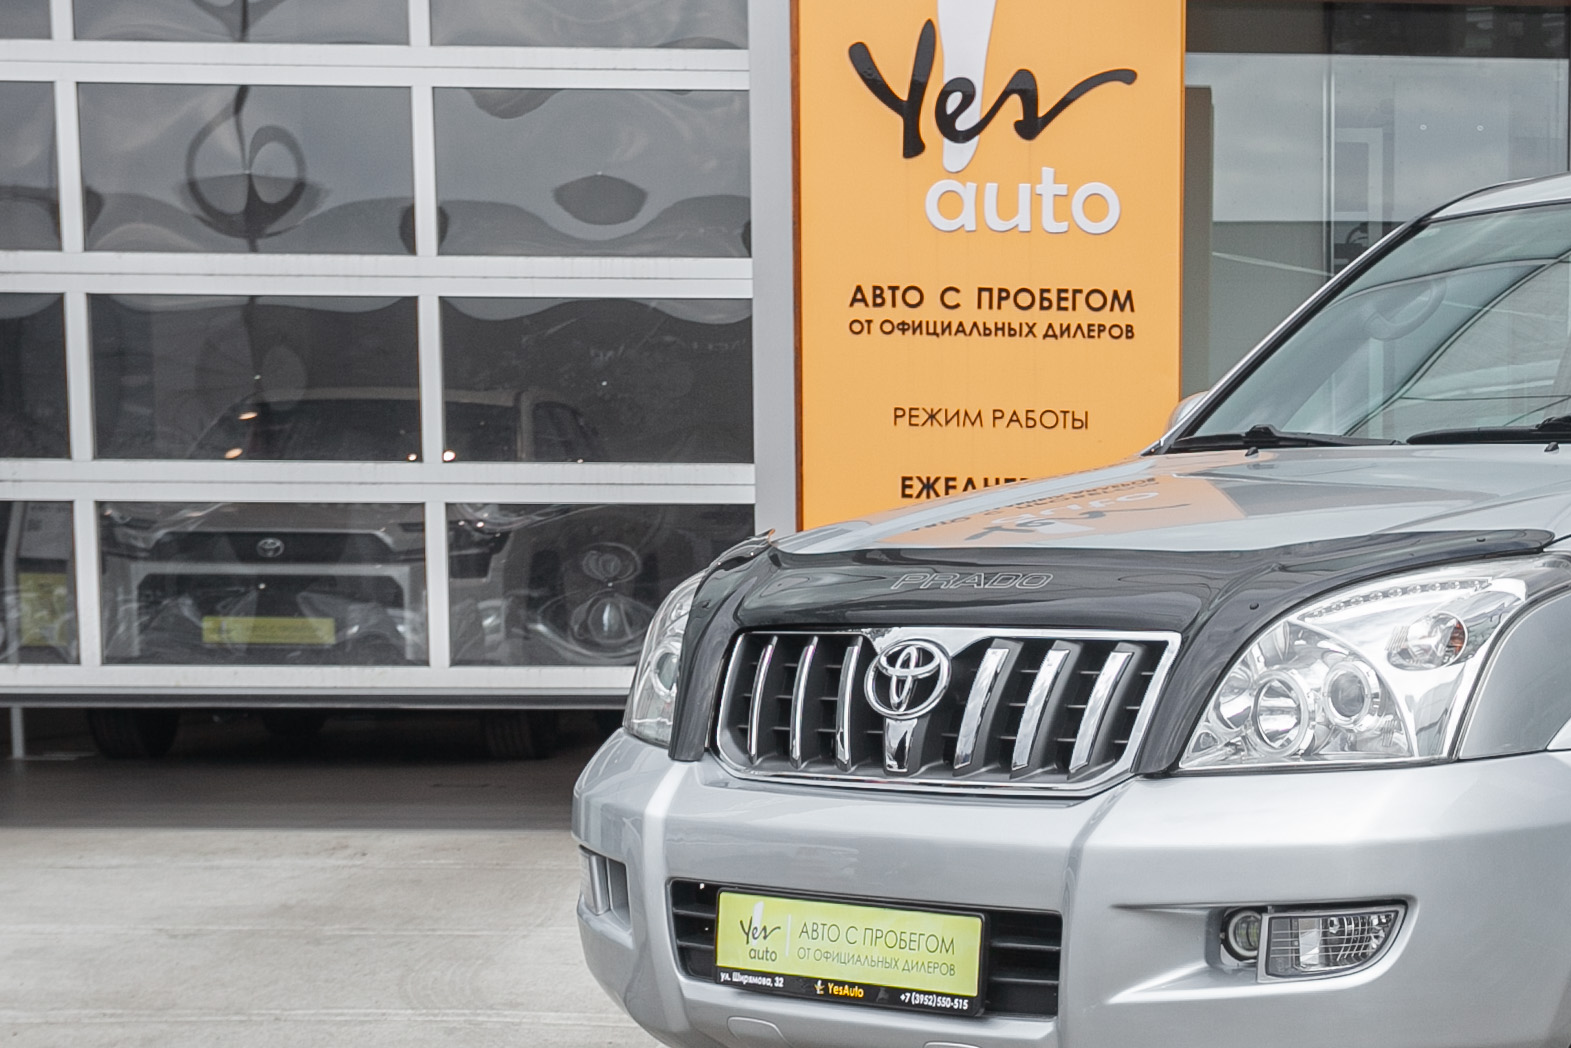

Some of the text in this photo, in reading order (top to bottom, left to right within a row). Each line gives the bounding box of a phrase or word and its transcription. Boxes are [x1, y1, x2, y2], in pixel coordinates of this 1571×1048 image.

[848, 18, 1138, 159] Yes
[925, 166, 1121, 234] auto
[849, 284, 1136, 313] АВТО С ПРОБЕГОМ
[848, 318, 1136, 340] ОТ ОФИЦИАЛЬНЫХ ДИЛЕРОВ
[892, 406, 1090, 430] РЕЖИМ РАБОТЫ
[900, 475, 1029, 499] ЕЖЕД
[890, 572, 1054, 590] PRADO
[738, 915, 781, 945] Yes
[798, 921, 956, 956] АВТО С ПРОБЕГОМ
[748, 945, 778, 962] auto
[796, 946, 956, 977] ОТ ОФИЦИАЛЬНЫХ ДИЛЕРОВ
[773, 976, 784, 988] 32
[827, 981, 864, 998] YesAuto
[899, 992, 911, 1004] +7
